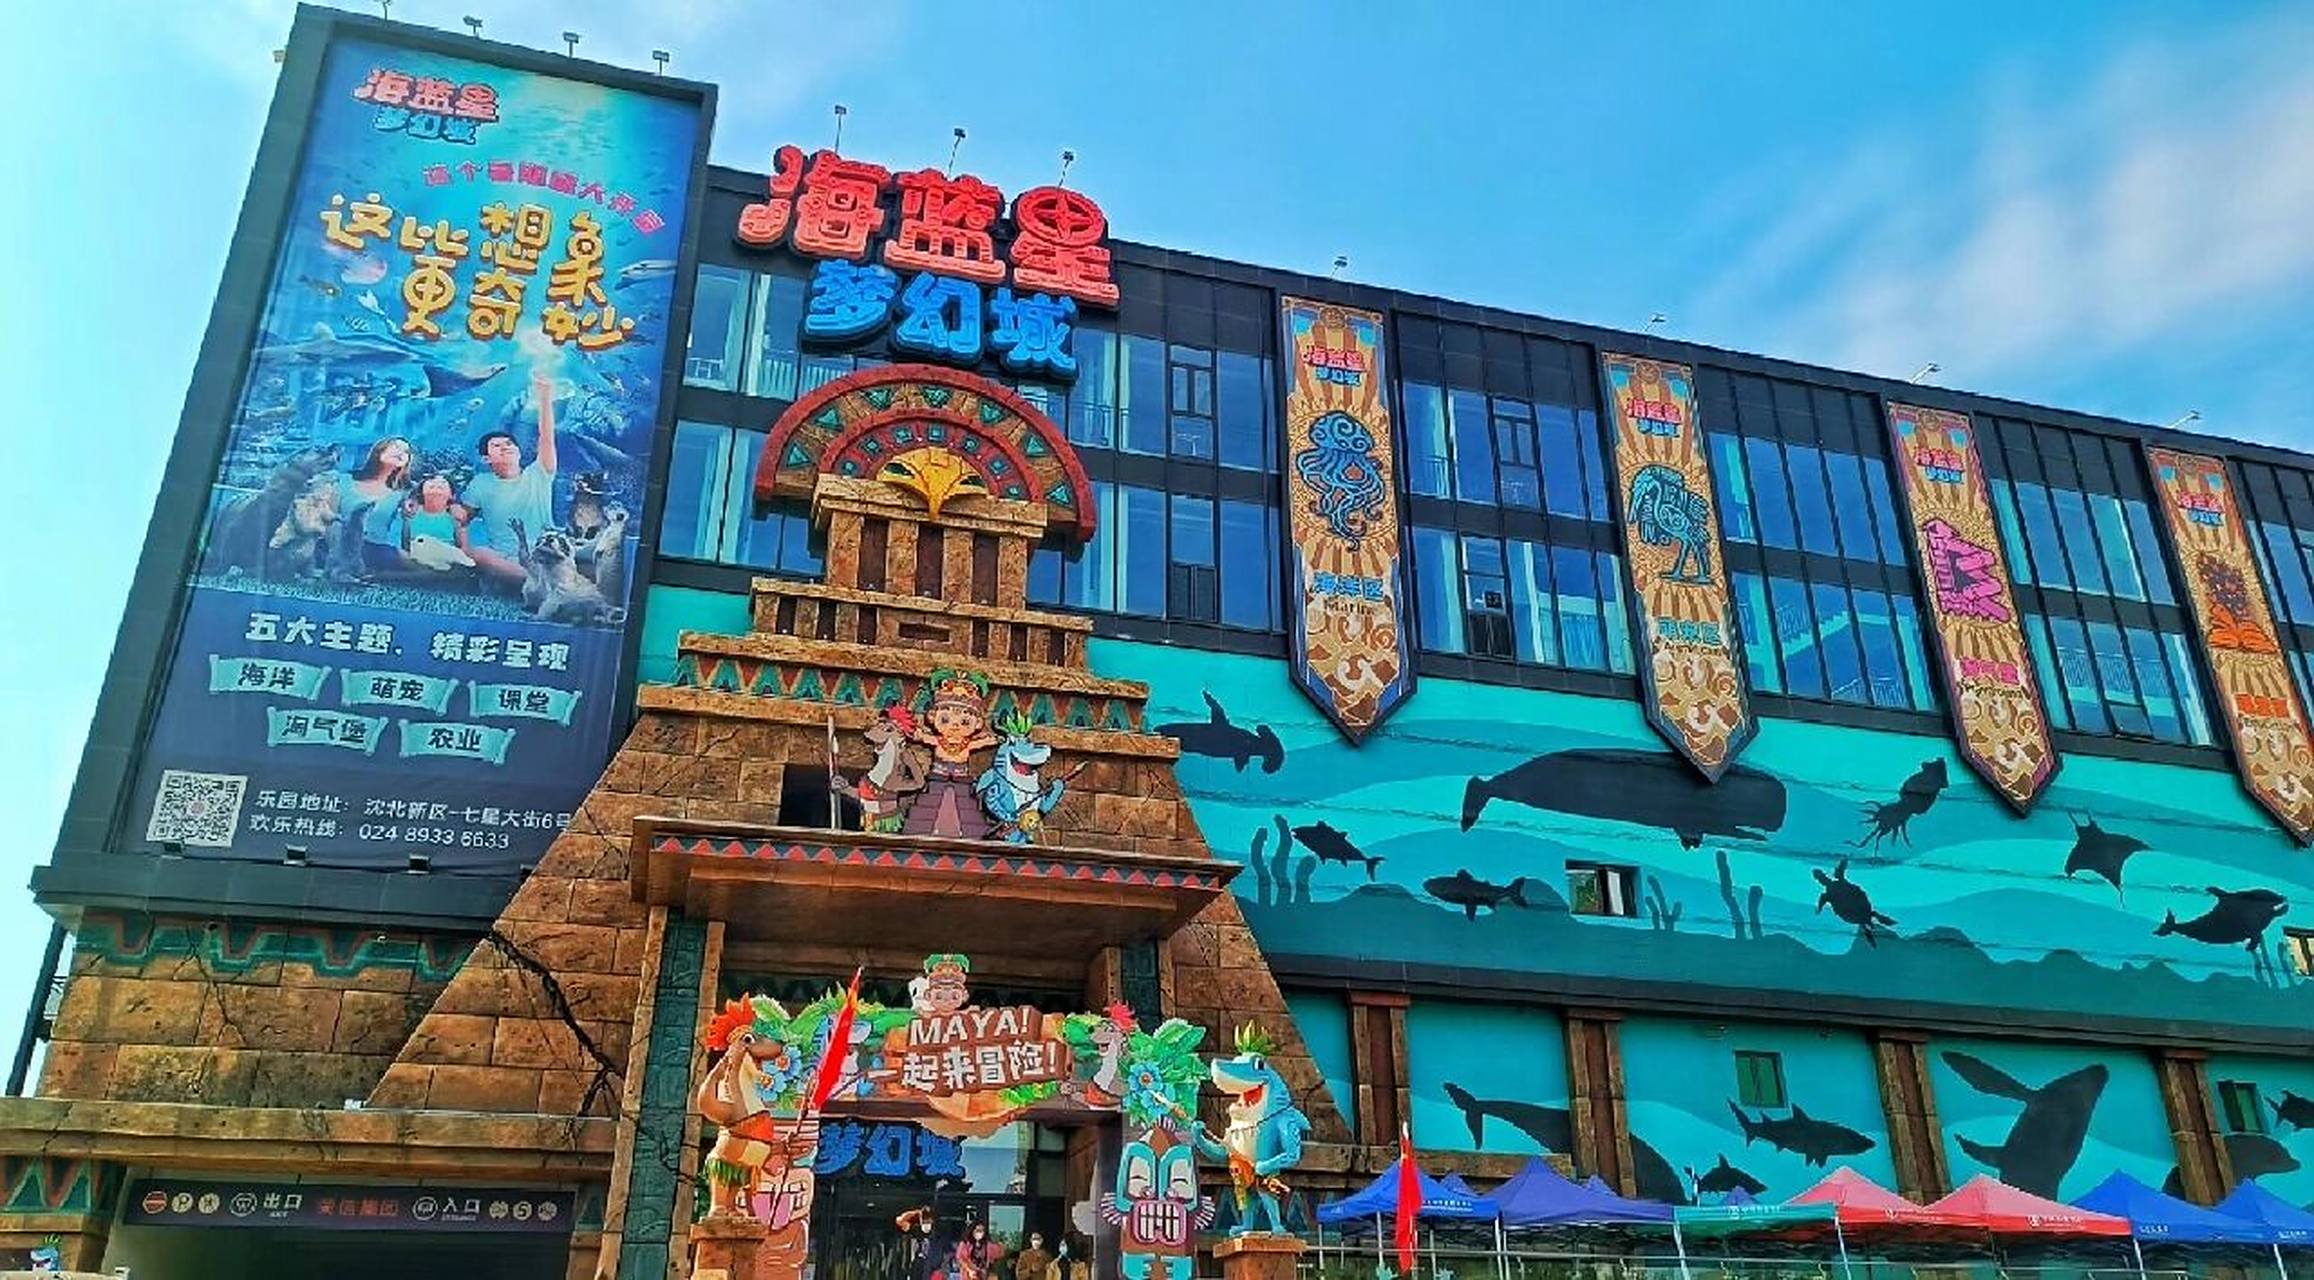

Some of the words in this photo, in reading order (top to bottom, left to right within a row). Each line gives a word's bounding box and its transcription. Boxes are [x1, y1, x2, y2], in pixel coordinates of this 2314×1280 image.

[353, 69, 499, 122] 海蓝星
[737, 145, 1120, 302] 海蓝星
[402, 255, 637, 348] 更奇妙
[804, 259, 1077, 376] 梦幻城
[430, 631, 570, 672] 精彩呈现
[237, 663, 296, 690] 海洋
[370, 676, 425, 702] 萌宠
[499, 688, 549, 714] 课堂
[282, 715, 368, 745] 淘气堡
[427, 727, 482, 753] 农业
[359, 823, 400, 841] 024
[404, 827, 455, 845] 8933
[460, 831, 510, 849] 6633
[910, 1007, 1030, 1046] MAYA!
[263, 1192, 303, 1211] 出口
[442, 1196, 481, 1213] 入口
